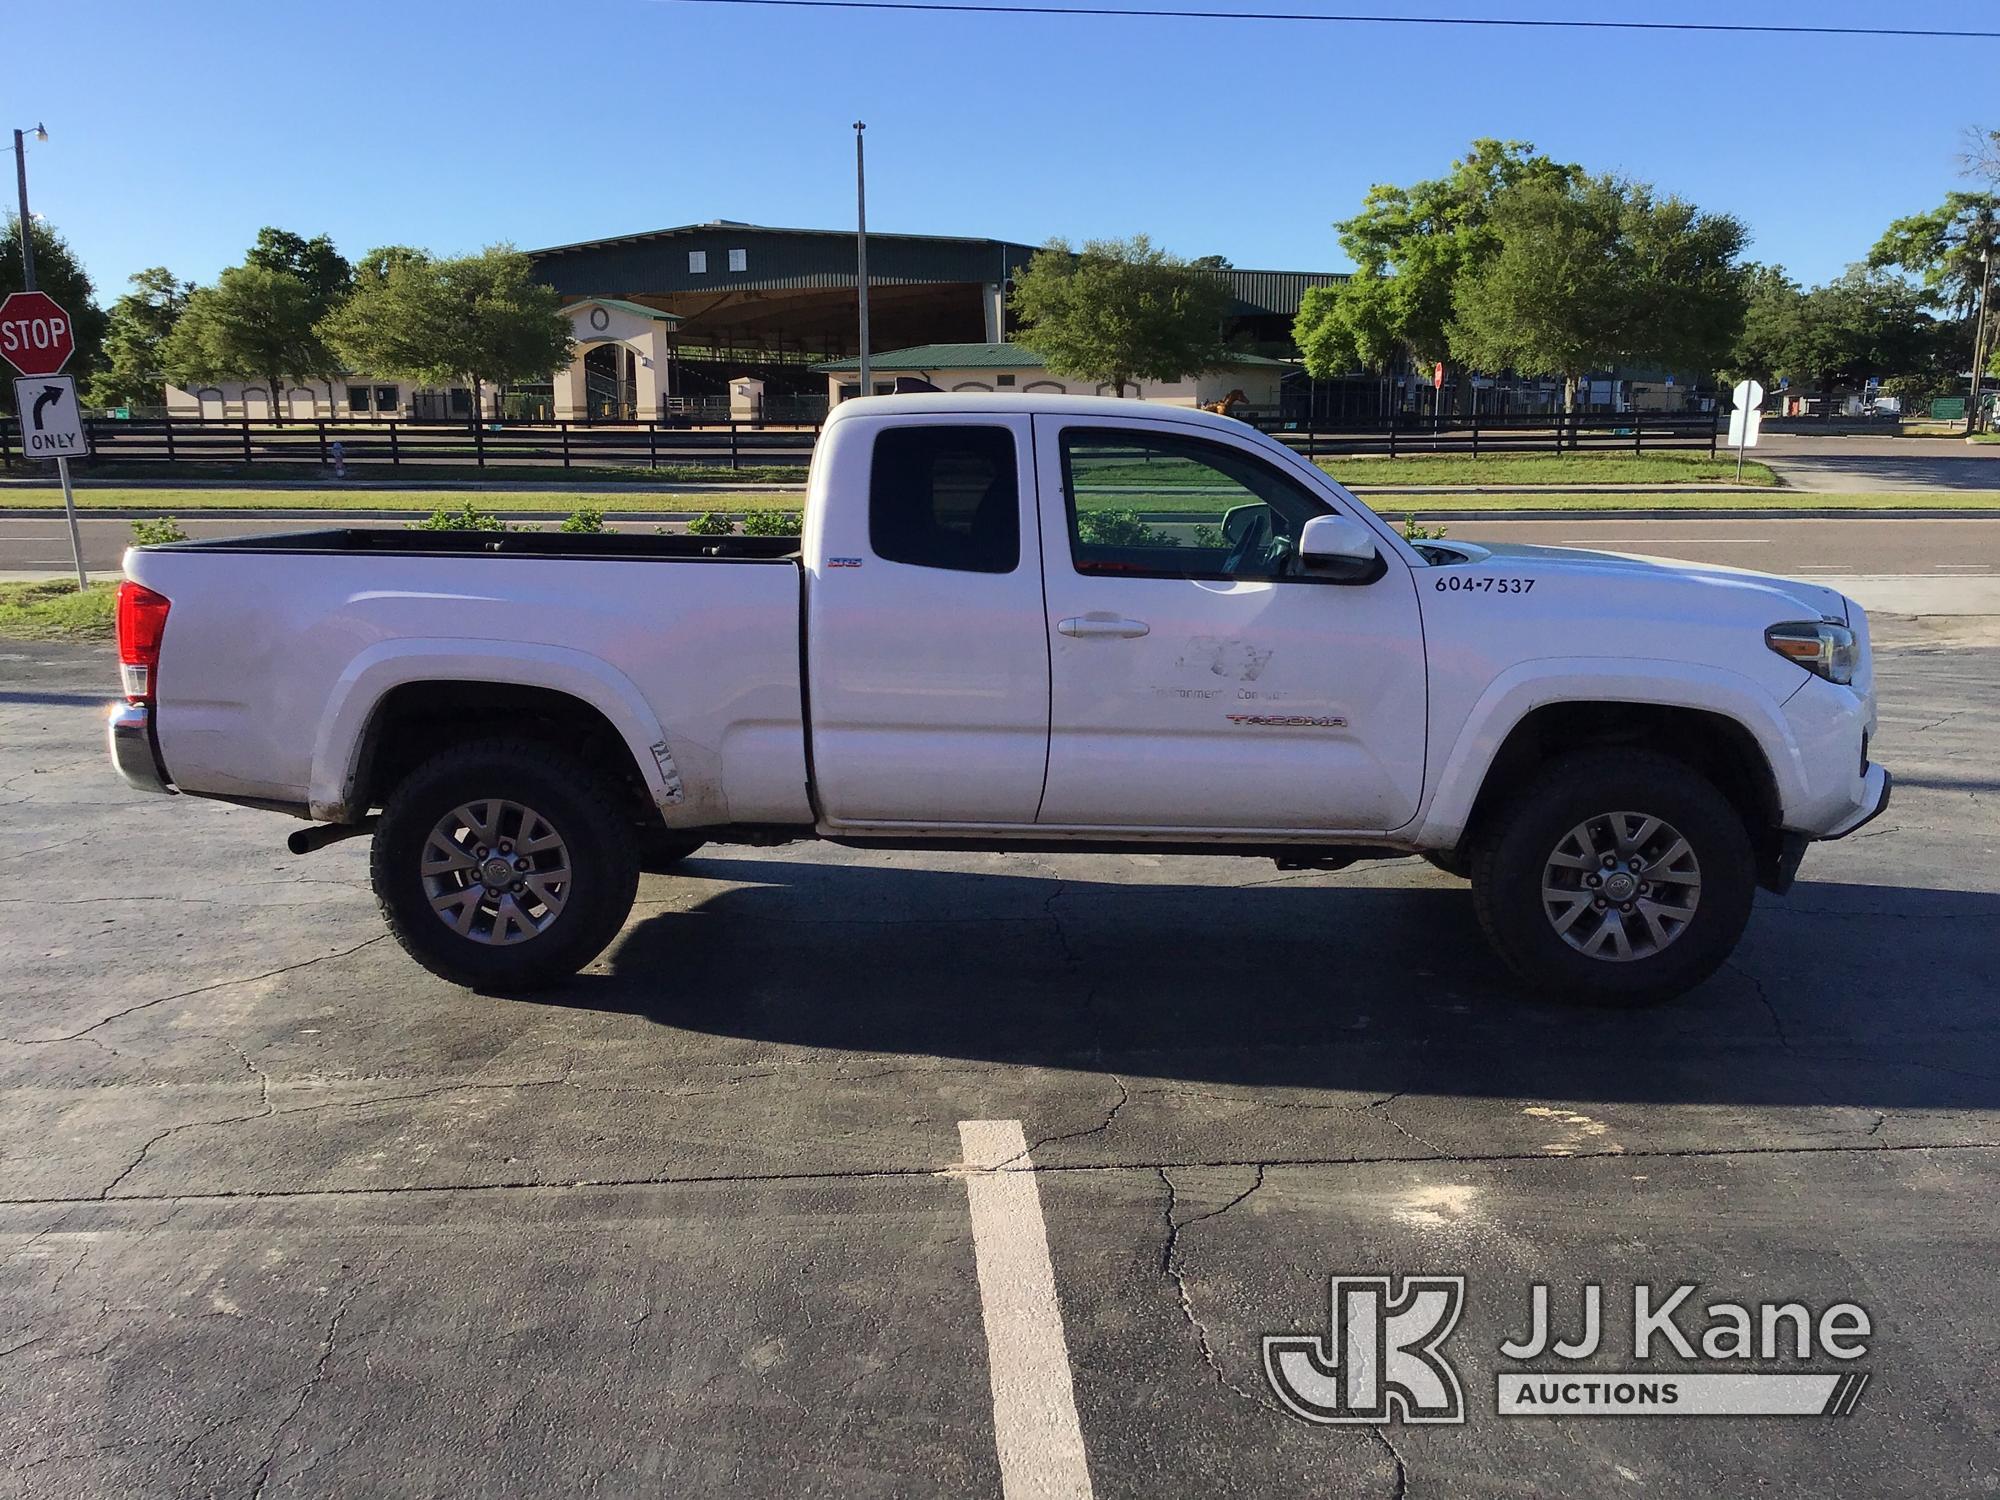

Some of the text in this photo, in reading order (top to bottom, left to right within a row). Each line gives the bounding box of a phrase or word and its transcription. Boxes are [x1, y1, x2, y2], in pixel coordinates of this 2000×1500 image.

[2, 318, 65, 351] STOP
[32, 433, 75, 449] ONLY
[1435, 576, 1535, 593] 604-7537
[1226, 714, 1348, 727] TACOMA
